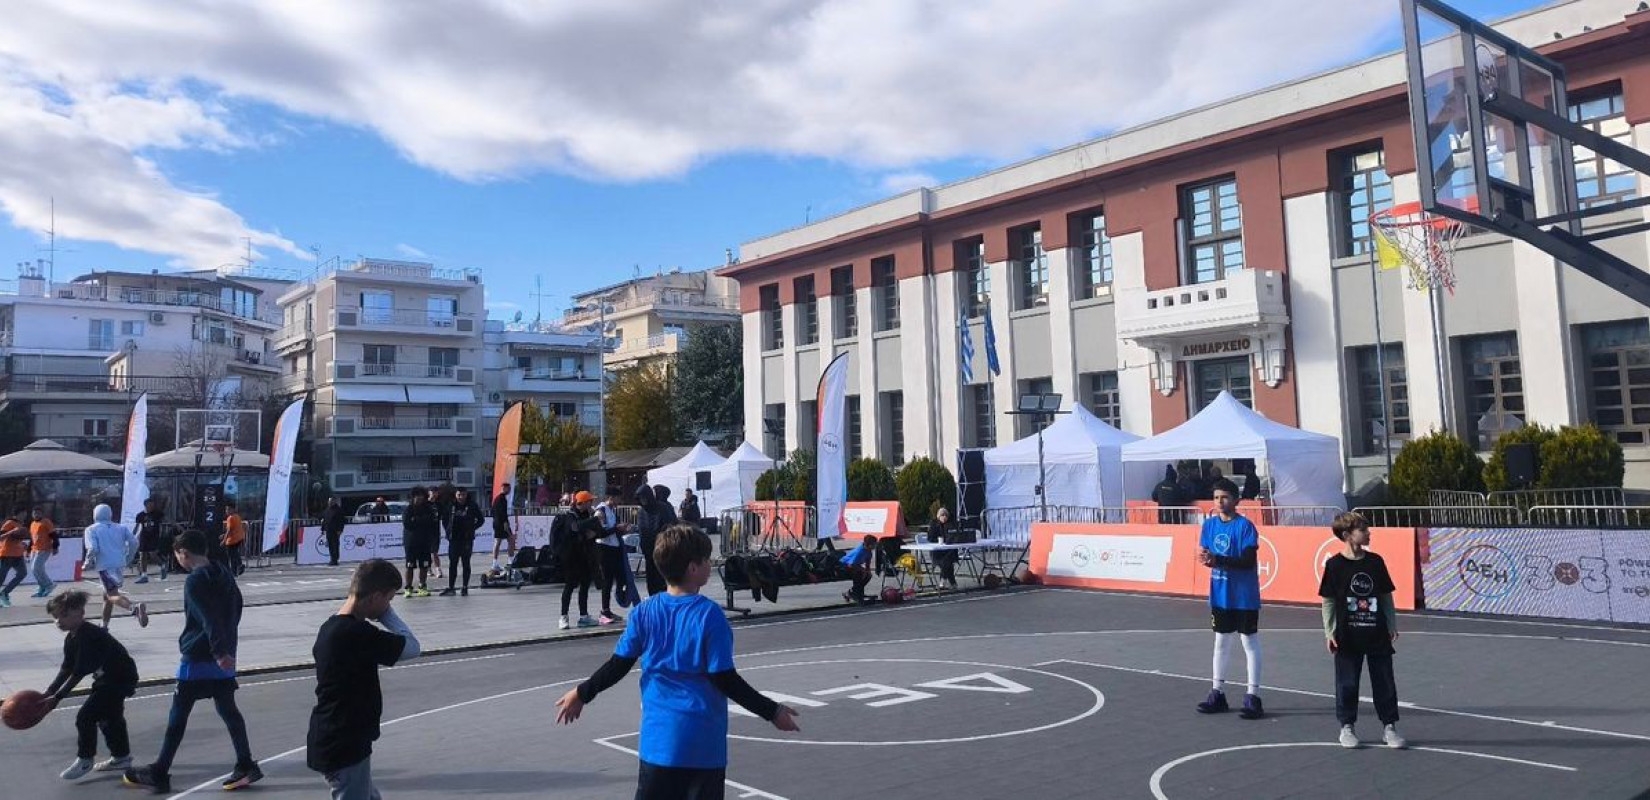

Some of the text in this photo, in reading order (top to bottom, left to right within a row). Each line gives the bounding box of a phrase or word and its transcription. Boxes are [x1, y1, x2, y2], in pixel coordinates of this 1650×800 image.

[1183, 338, 1251, 356] ΔΗΜΑΡΧΕΙΟ
[206, 511, 214, 520] 2
[1466, 559, 1508, 583] ΔΕΗ
[1621, 569, 1636, 577] TO
